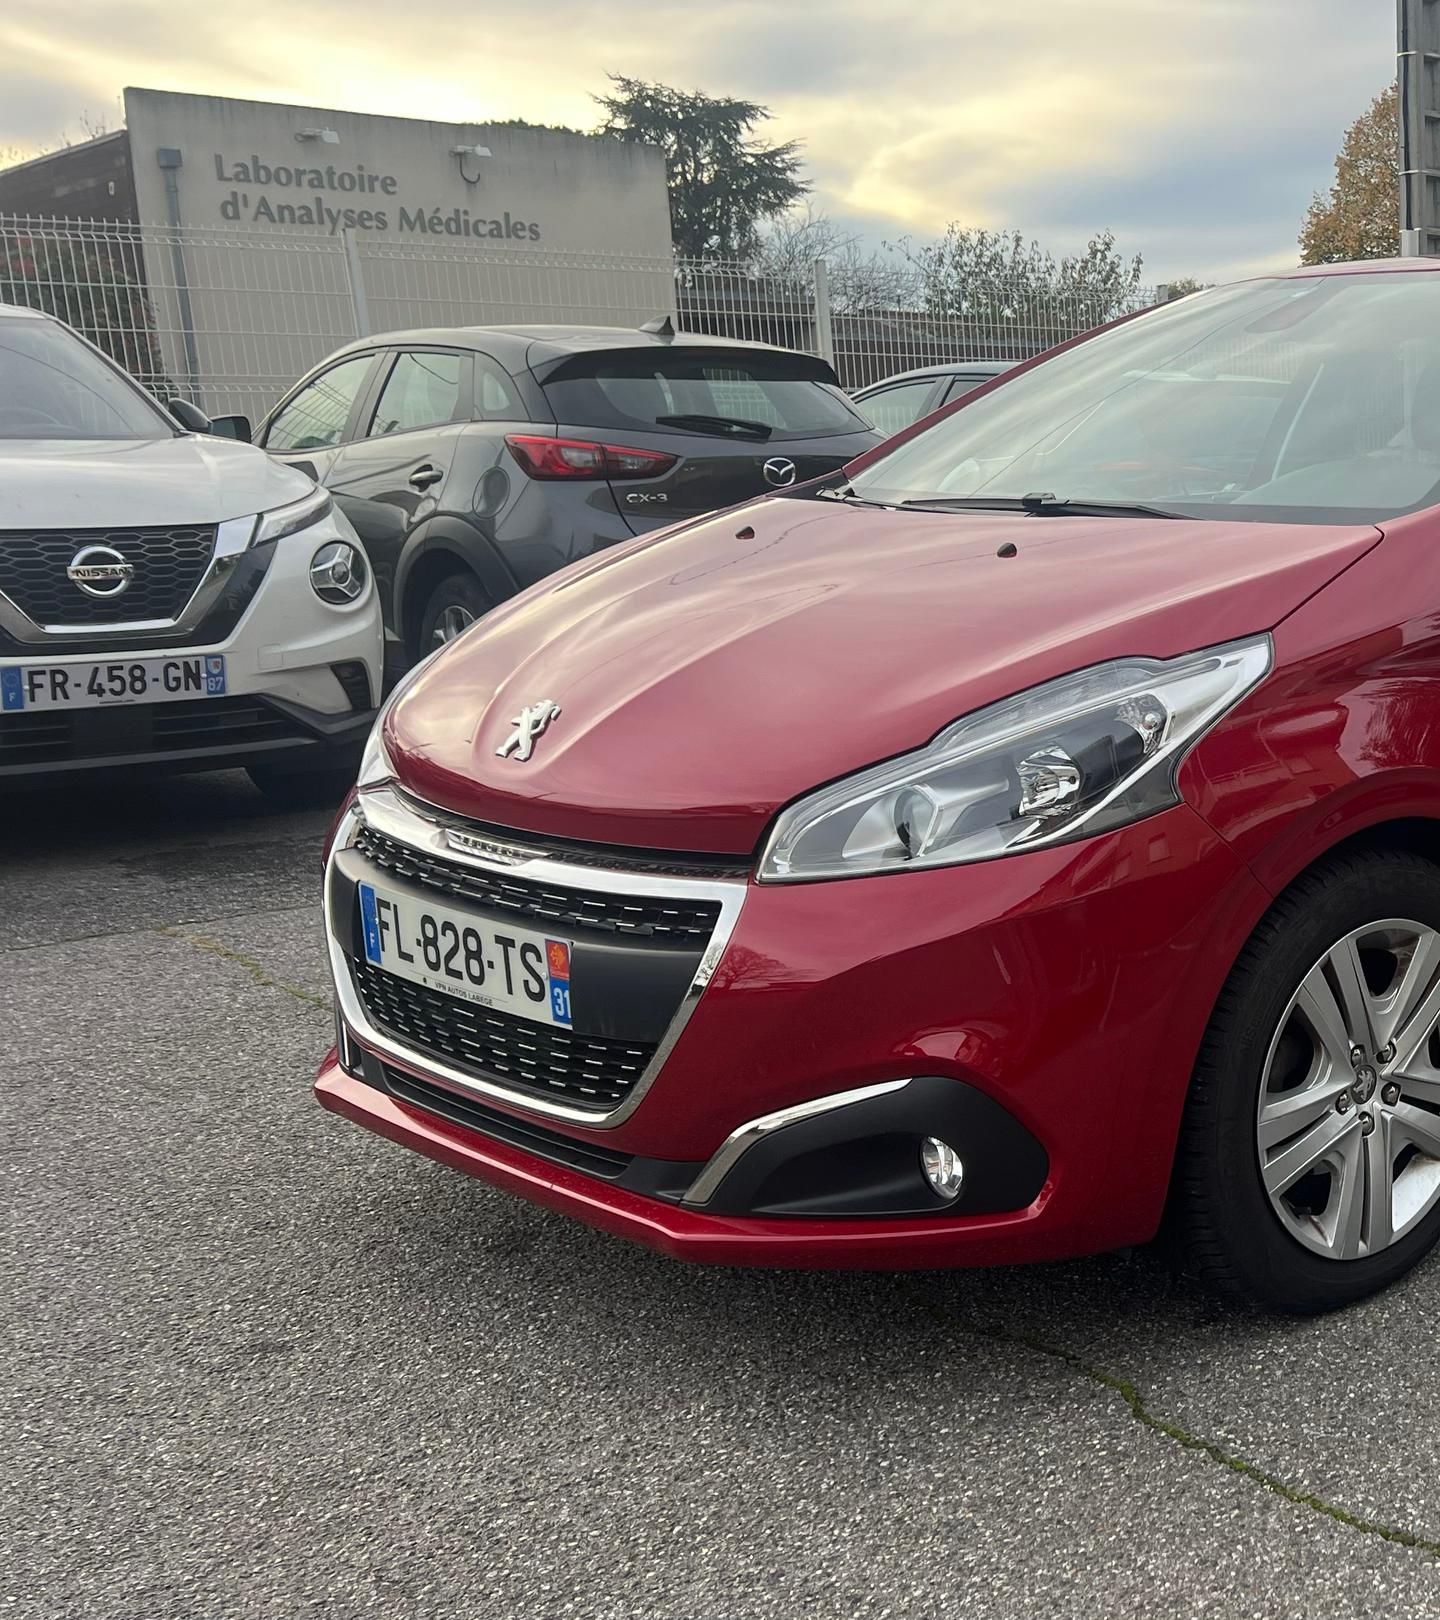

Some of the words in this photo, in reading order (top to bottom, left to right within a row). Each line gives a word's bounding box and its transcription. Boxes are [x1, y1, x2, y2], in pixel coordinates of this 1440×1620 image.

[214, 154, 397, 195] Laboratoire
[220, 191, 388, 235] d'Analyses
[398, 206, 540, 241] Médicales
[626, 493, 668, 503] CX-3
[75, 567, 128, 577] NISSAN
[27, 660, 201, 703] FR-458-GN
[208, 676, 224, 691] 87
[9, 693, 16, 702] F
[369, 932, 375, 948] F
[376, 897, 546, 1002] FL-828-TS
[447, 986, 468, 998] AUTOS
[553, 987, 573, 1019] 31
